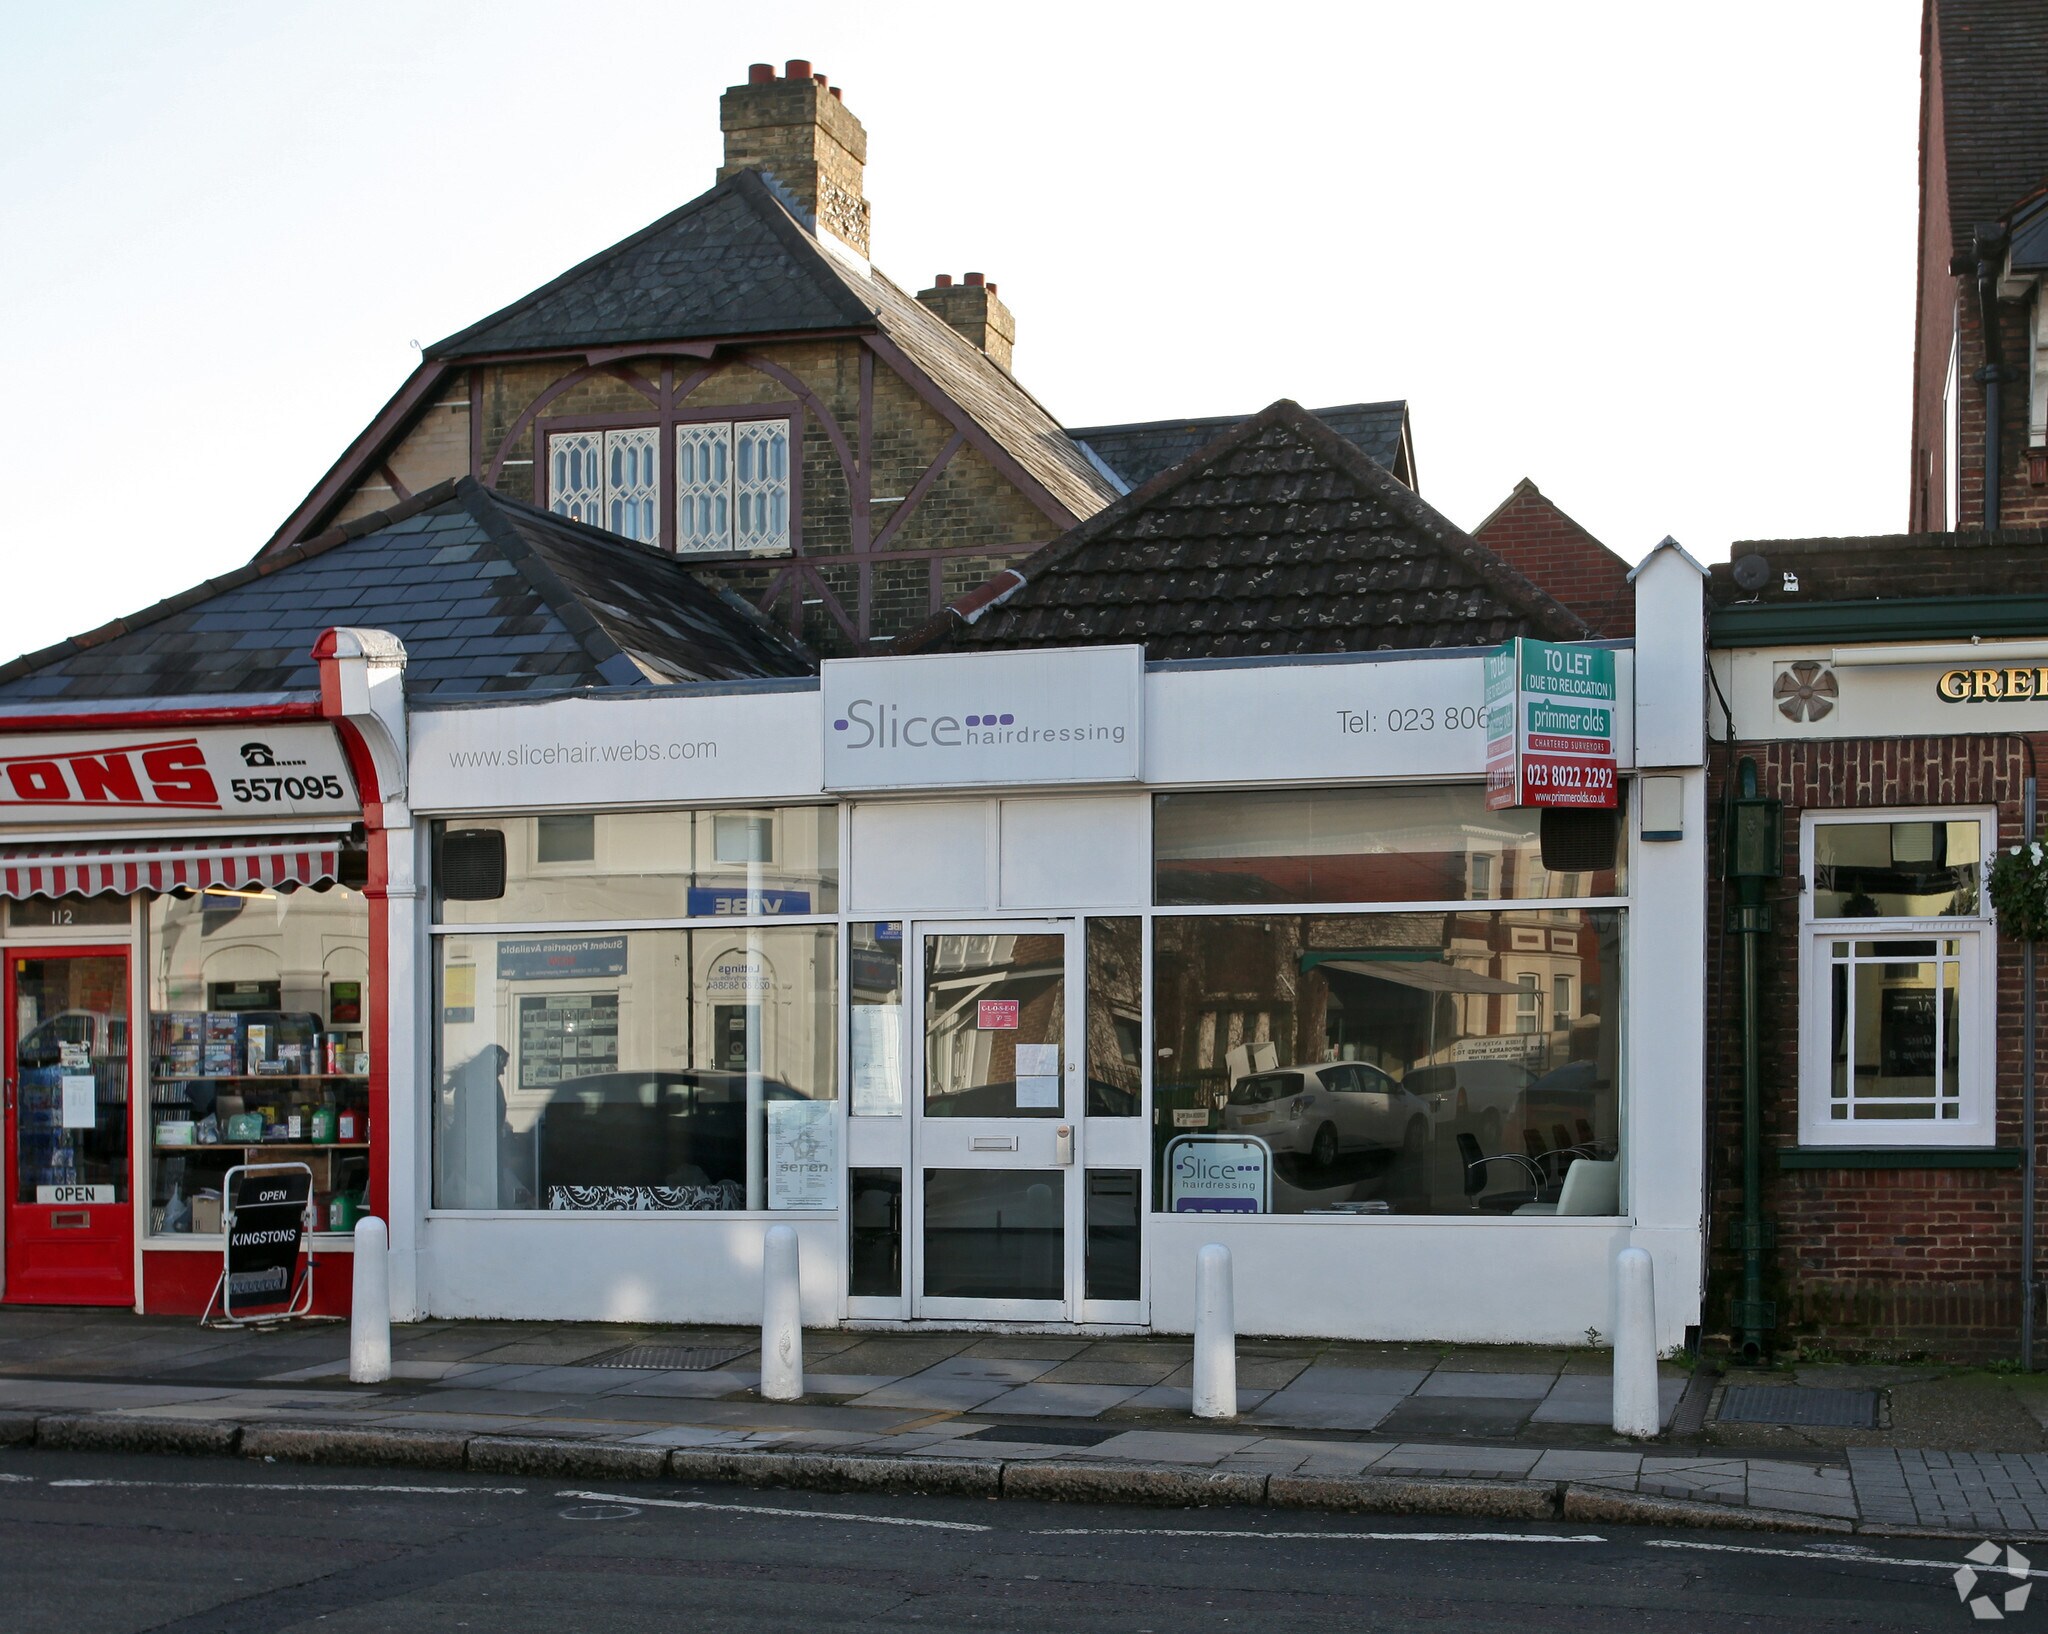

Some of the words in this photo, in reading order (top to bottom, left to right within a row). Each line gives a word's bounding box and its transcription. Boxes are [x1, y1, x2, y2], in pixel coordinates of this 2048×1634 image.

[1544, 649, 1562, 673] TO
[1567, 652, 1592, 675] LET
[1547, 677, 1557, 691] TO
[847, 699, 962, 749] Slice
[1336, 709, 1377, 734] Tel:
[1387, 707, 1435, 732] 023
[966, 723, 1125, 745] hairdressing
[449, 739, 717, 768] www.slicehair.webs.com
[1535, 739, 1569, 750] CHARTERED
[1571, 741, 1604, 752] SURVEYORS
[0, 745, 219, 803] ONS
[1527, 764, 1548, 786] 023
[1552, 765, 1581, 787] 8022
[1584, 767, 1613, 789] 2292
[231, 775, 344, 803] 557095
[1535, 791, 1606, 805] www.primmerolds.co.uk
[51, 910, 73, 925] 112
[780, 1163, 829, 1173] seren
[1182, 1155, 1236, 1180] Slice
[55, 1187, 96, 1202] OPEN
[1182, 1181, 1256, 1191] hairdressing
[260, 1190, 287, 1202] OPEN
[231, 1229, 297, 1246] KINGSTONS
